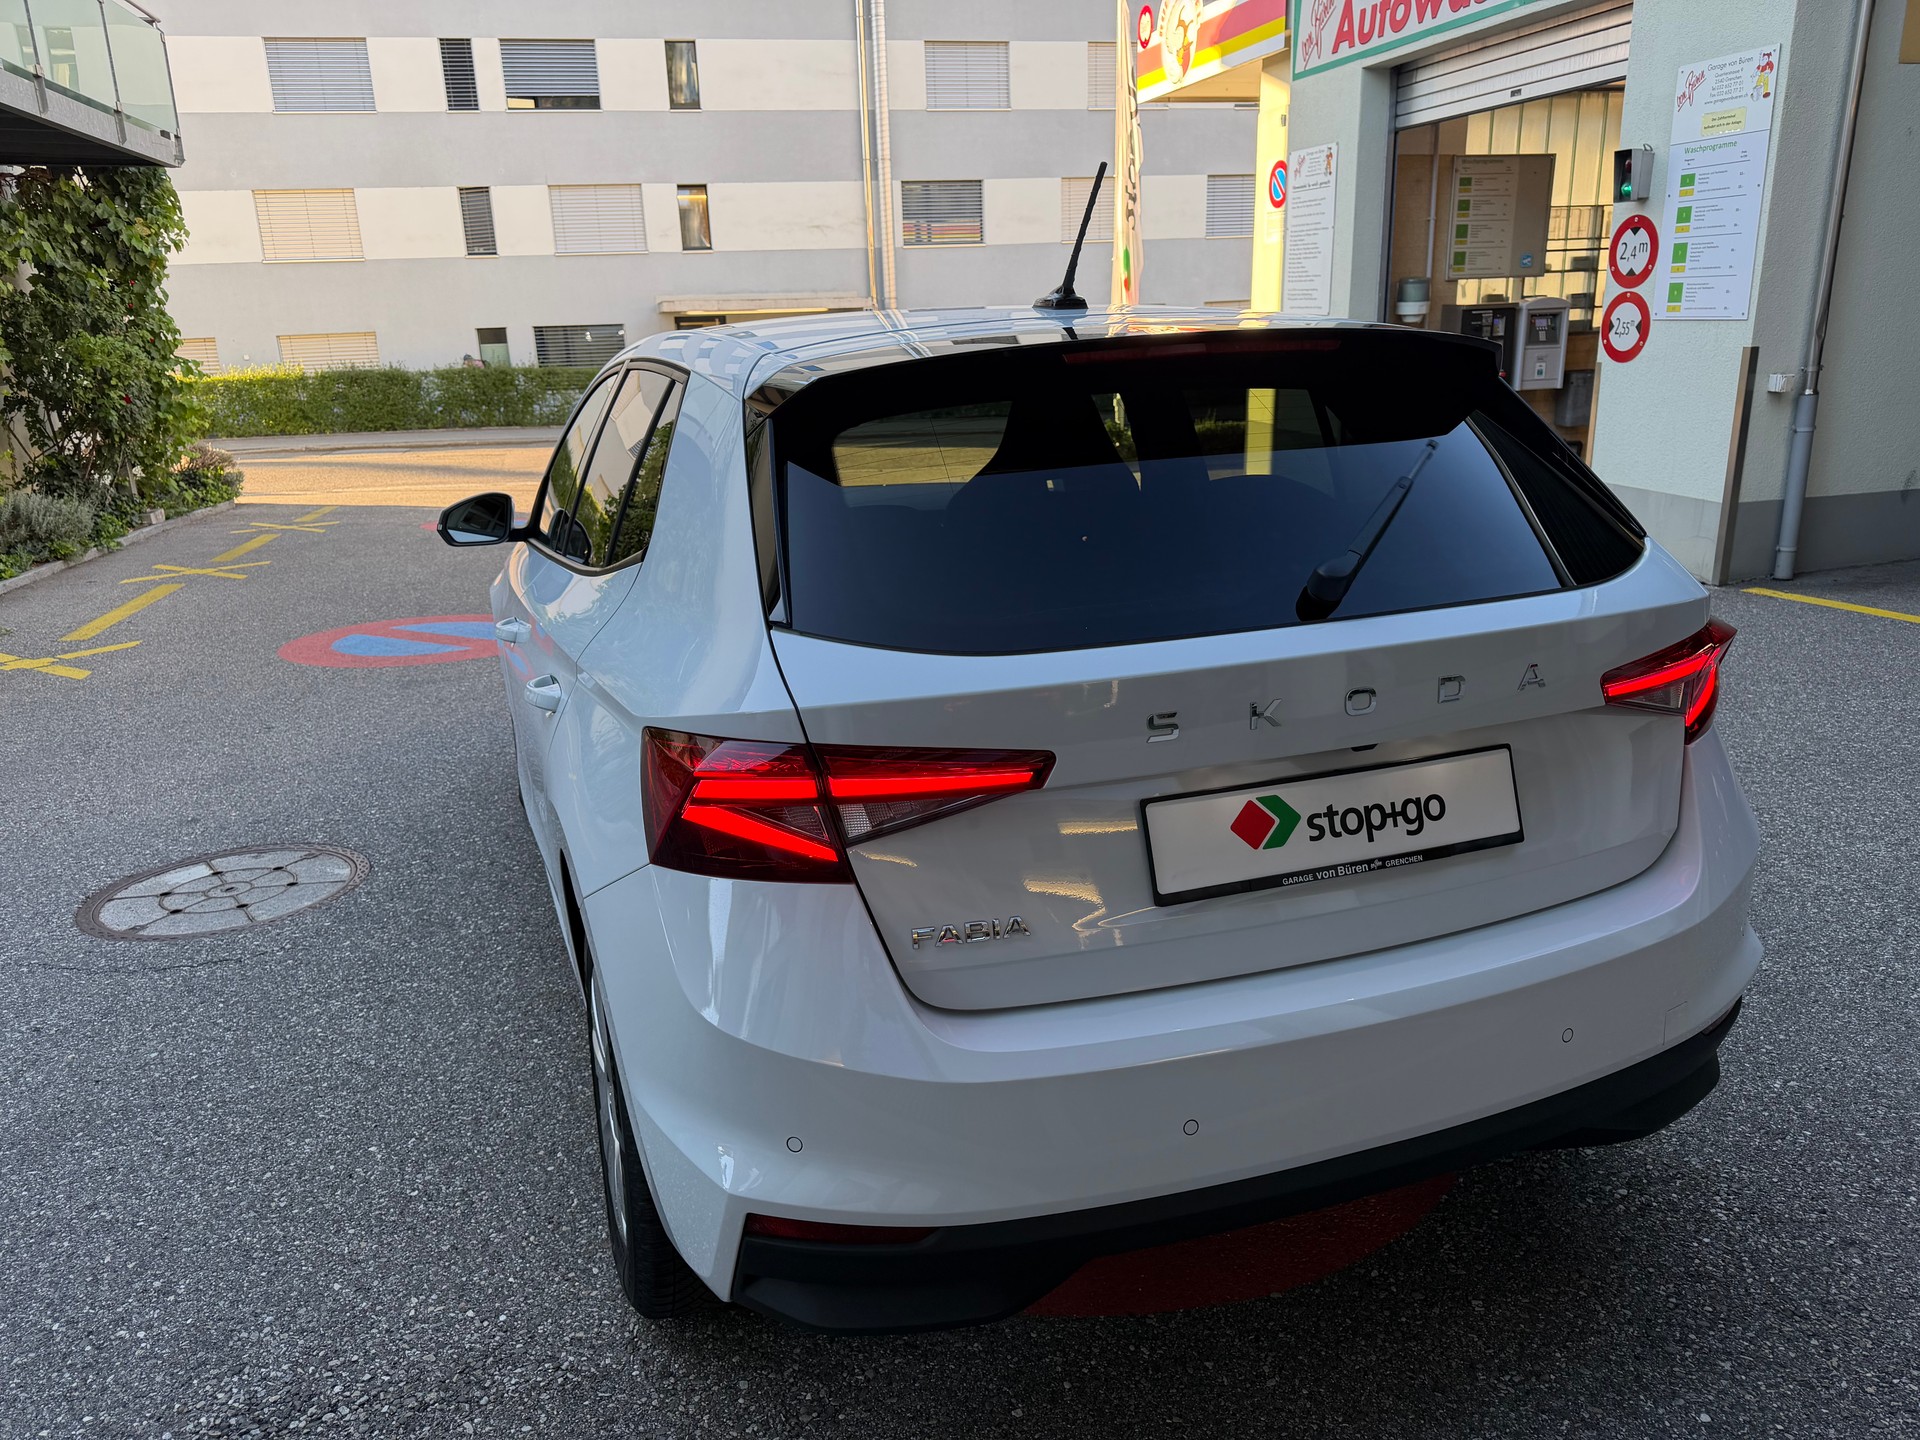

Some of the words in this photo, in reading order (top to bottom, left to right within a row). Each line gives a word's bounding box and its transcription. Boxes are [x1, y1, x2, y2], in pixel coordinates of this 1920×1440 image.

[1708, 62, 1727, 72] Garage
[1738, 56, 1754, 65] Büren
[1684, 141, 1737, 154] Waschprogramme
[1146, 662, 1547, 743] SKODA
[1306, 793, 1446, 843] stop+go
[1282, 873, 1314, 886] GARAGE
[1316, 869, 1336, 880] von
[1337, 863, 1369, 876] Büren
[1385, 855, 1423, 868] GRENCHEN
[910, 915, 1032, 950] FABIA
